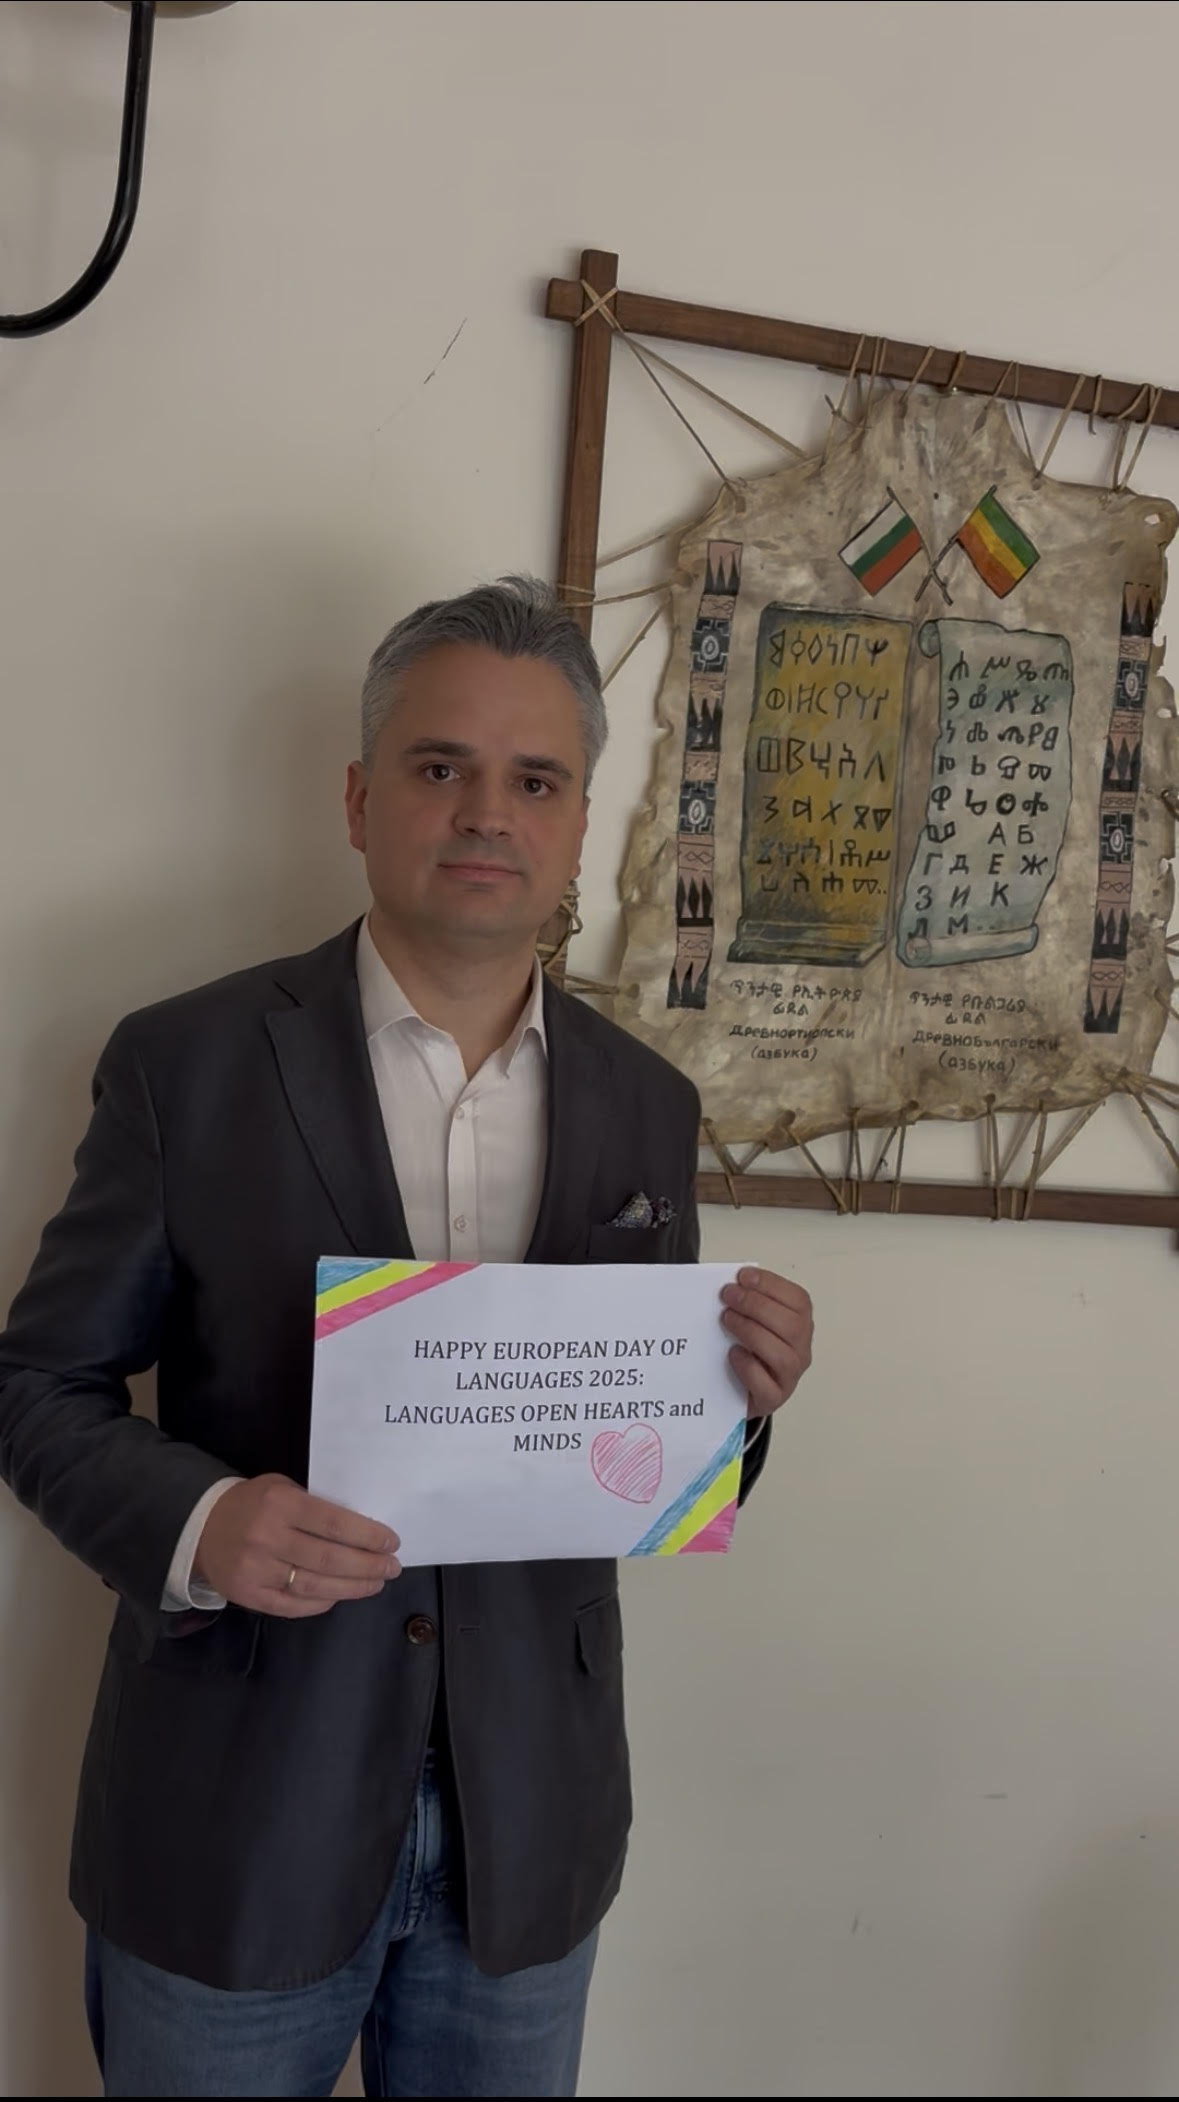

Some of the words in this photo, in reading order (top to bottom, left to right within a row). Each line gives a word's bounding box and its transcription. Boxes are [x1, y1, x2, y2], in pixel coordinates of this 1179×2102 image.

[413, 1339, 487, 1360] HAPPY
[493, 1340, 608, 1360] EUROPEAN
[614, 1339, 656, 1358] DAY
[660, 1338, 687, 1356] OF
[456, 1371, 584, 1391] LANGUAGES
[588, 1369, 644, 1388] 2025:
[384, 1404, 515, 1424] LANGUAGES
[521, 1403, 577, 1422] OPEN
[583, 1401, 665, 1421] HEARTS
[669, 1398, 704, 1417] and
[513, 1433, 582, 1452] MINDS
